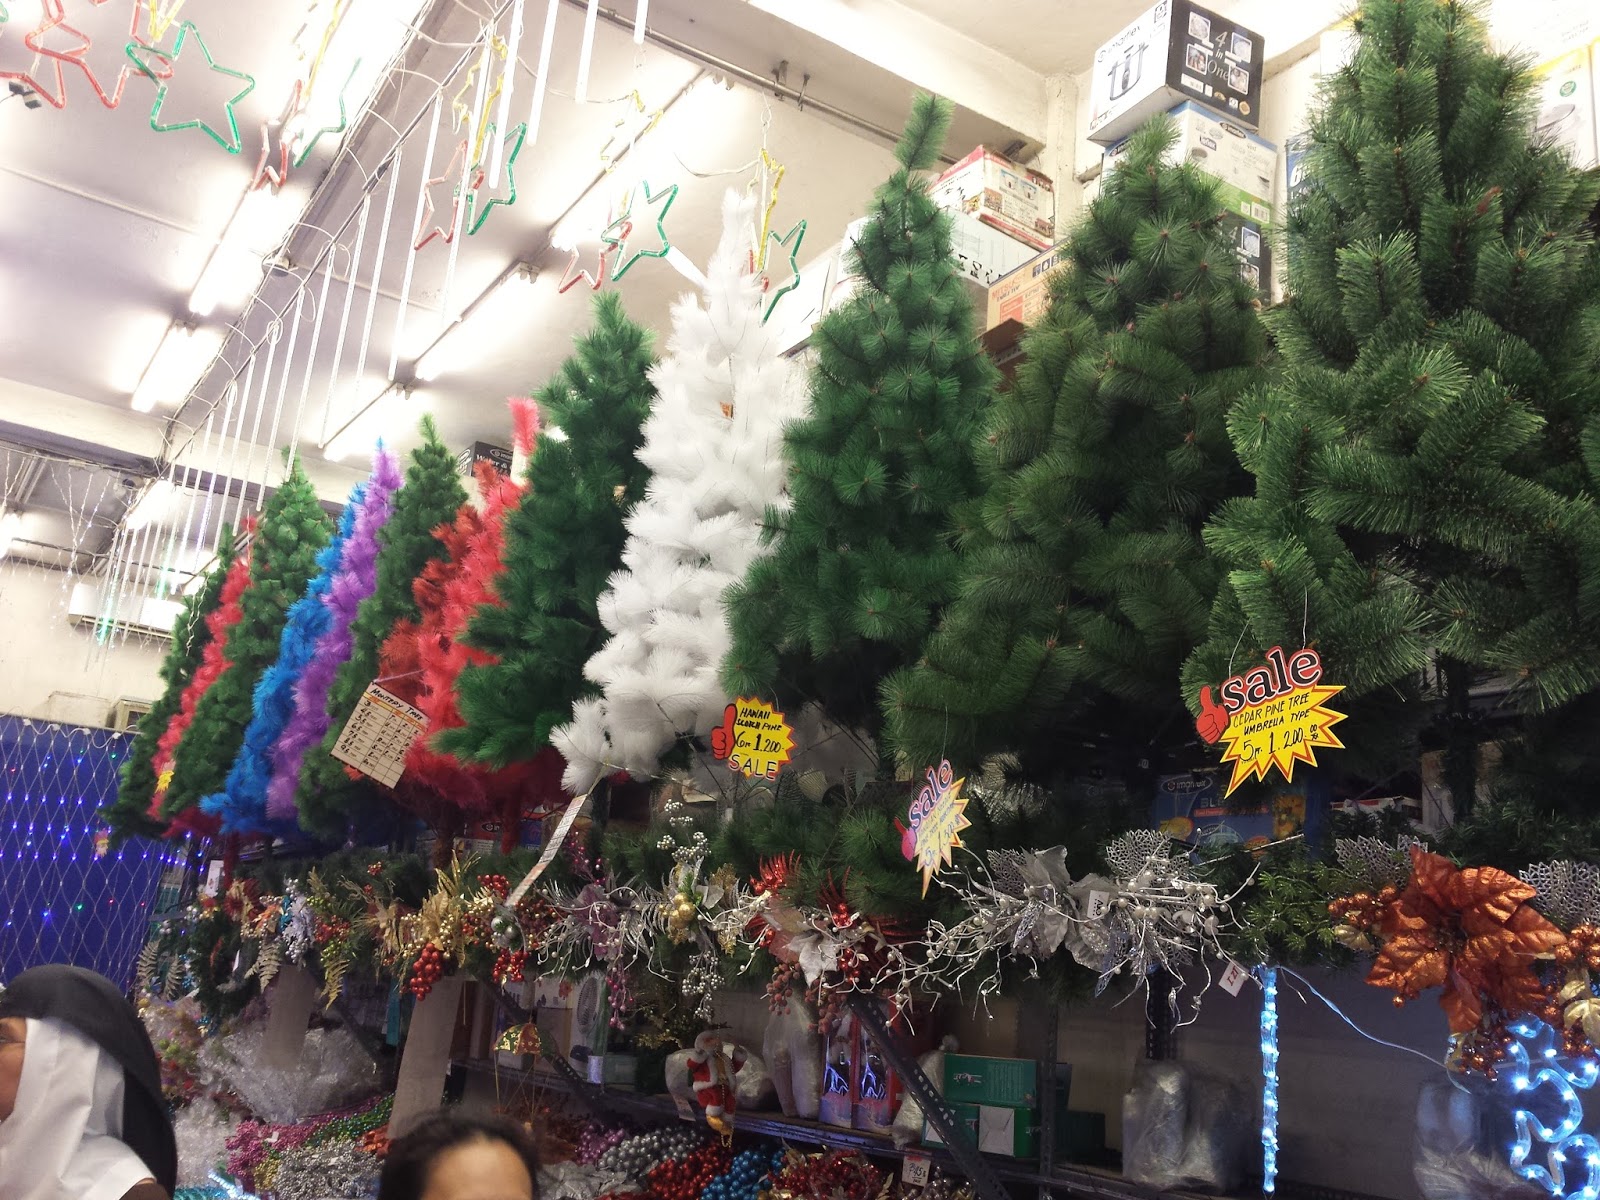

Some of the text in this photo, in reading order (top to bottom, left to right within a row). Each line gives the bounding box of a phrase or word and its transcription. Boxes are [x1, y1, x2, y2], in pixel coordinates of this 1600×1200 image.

[1215, 31, 1228, 47] 4
[1215, 48, 1224, 59] in
[1207, 60, 1229, 80] One
[1222, 648, 1322, 714] sale
[740, 707, 771, 720] HAWAII
[1233, 691, 1311, 728] CEDAR PINE TREE
[762, 722, 782, 731] PINE
[1243, 709, 1310, 736] UMBRELLA TYPE
[729, 754, 777, 780] SALE
[909, 761, 953, 831] sale
